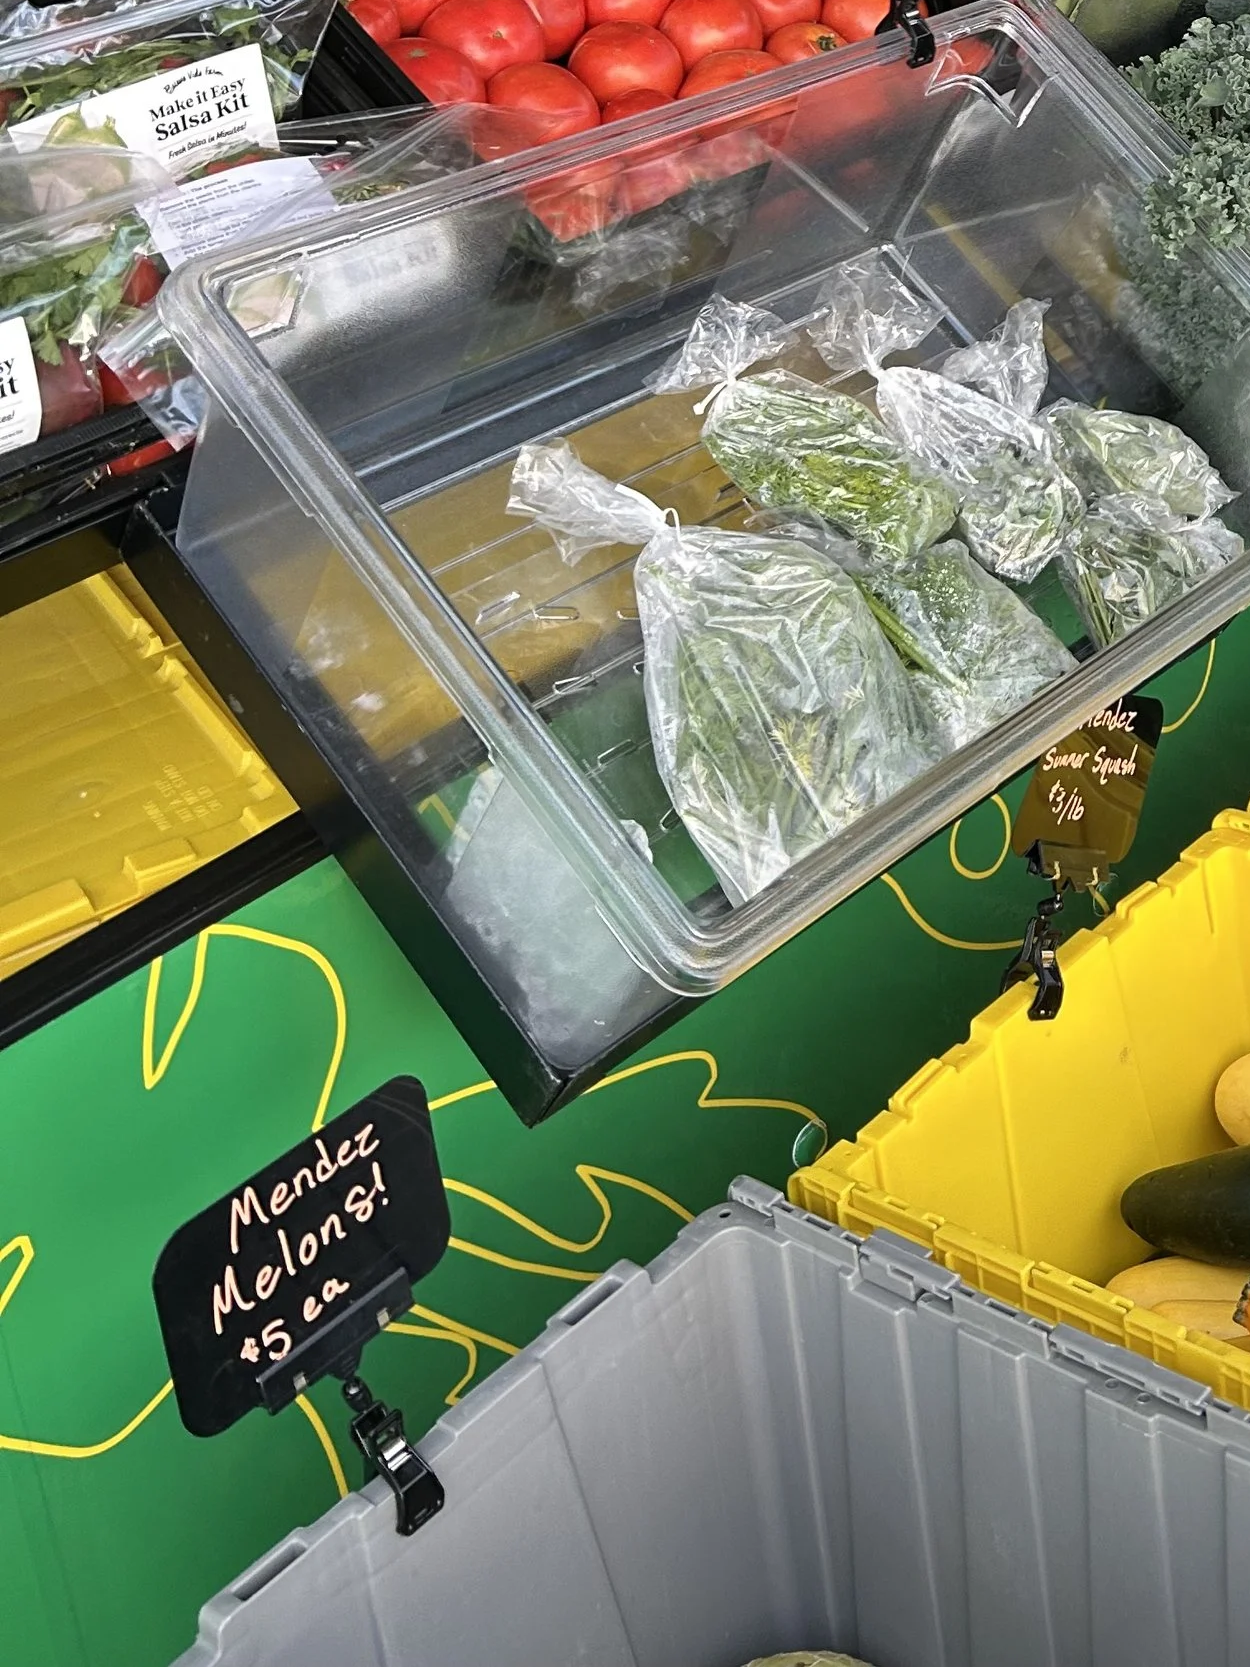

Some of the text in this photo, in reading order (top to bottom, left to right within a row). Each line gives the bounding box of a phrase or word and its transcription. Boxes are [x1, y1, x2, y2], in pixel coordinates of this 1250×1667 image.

[149, 77, 245, 122] Make it Easy
[155, 92, 250, 142] Salsa Kit
[168, 121, 247, 160] Fresh Salsa in Minutes!
[1092, 744, 1139, 785] Squash
[229, 1123, 380, 1253] Mendez
[211, 1162, 390, 1335] Melons!
[239, 1276, 350, 1363] $5 ea
